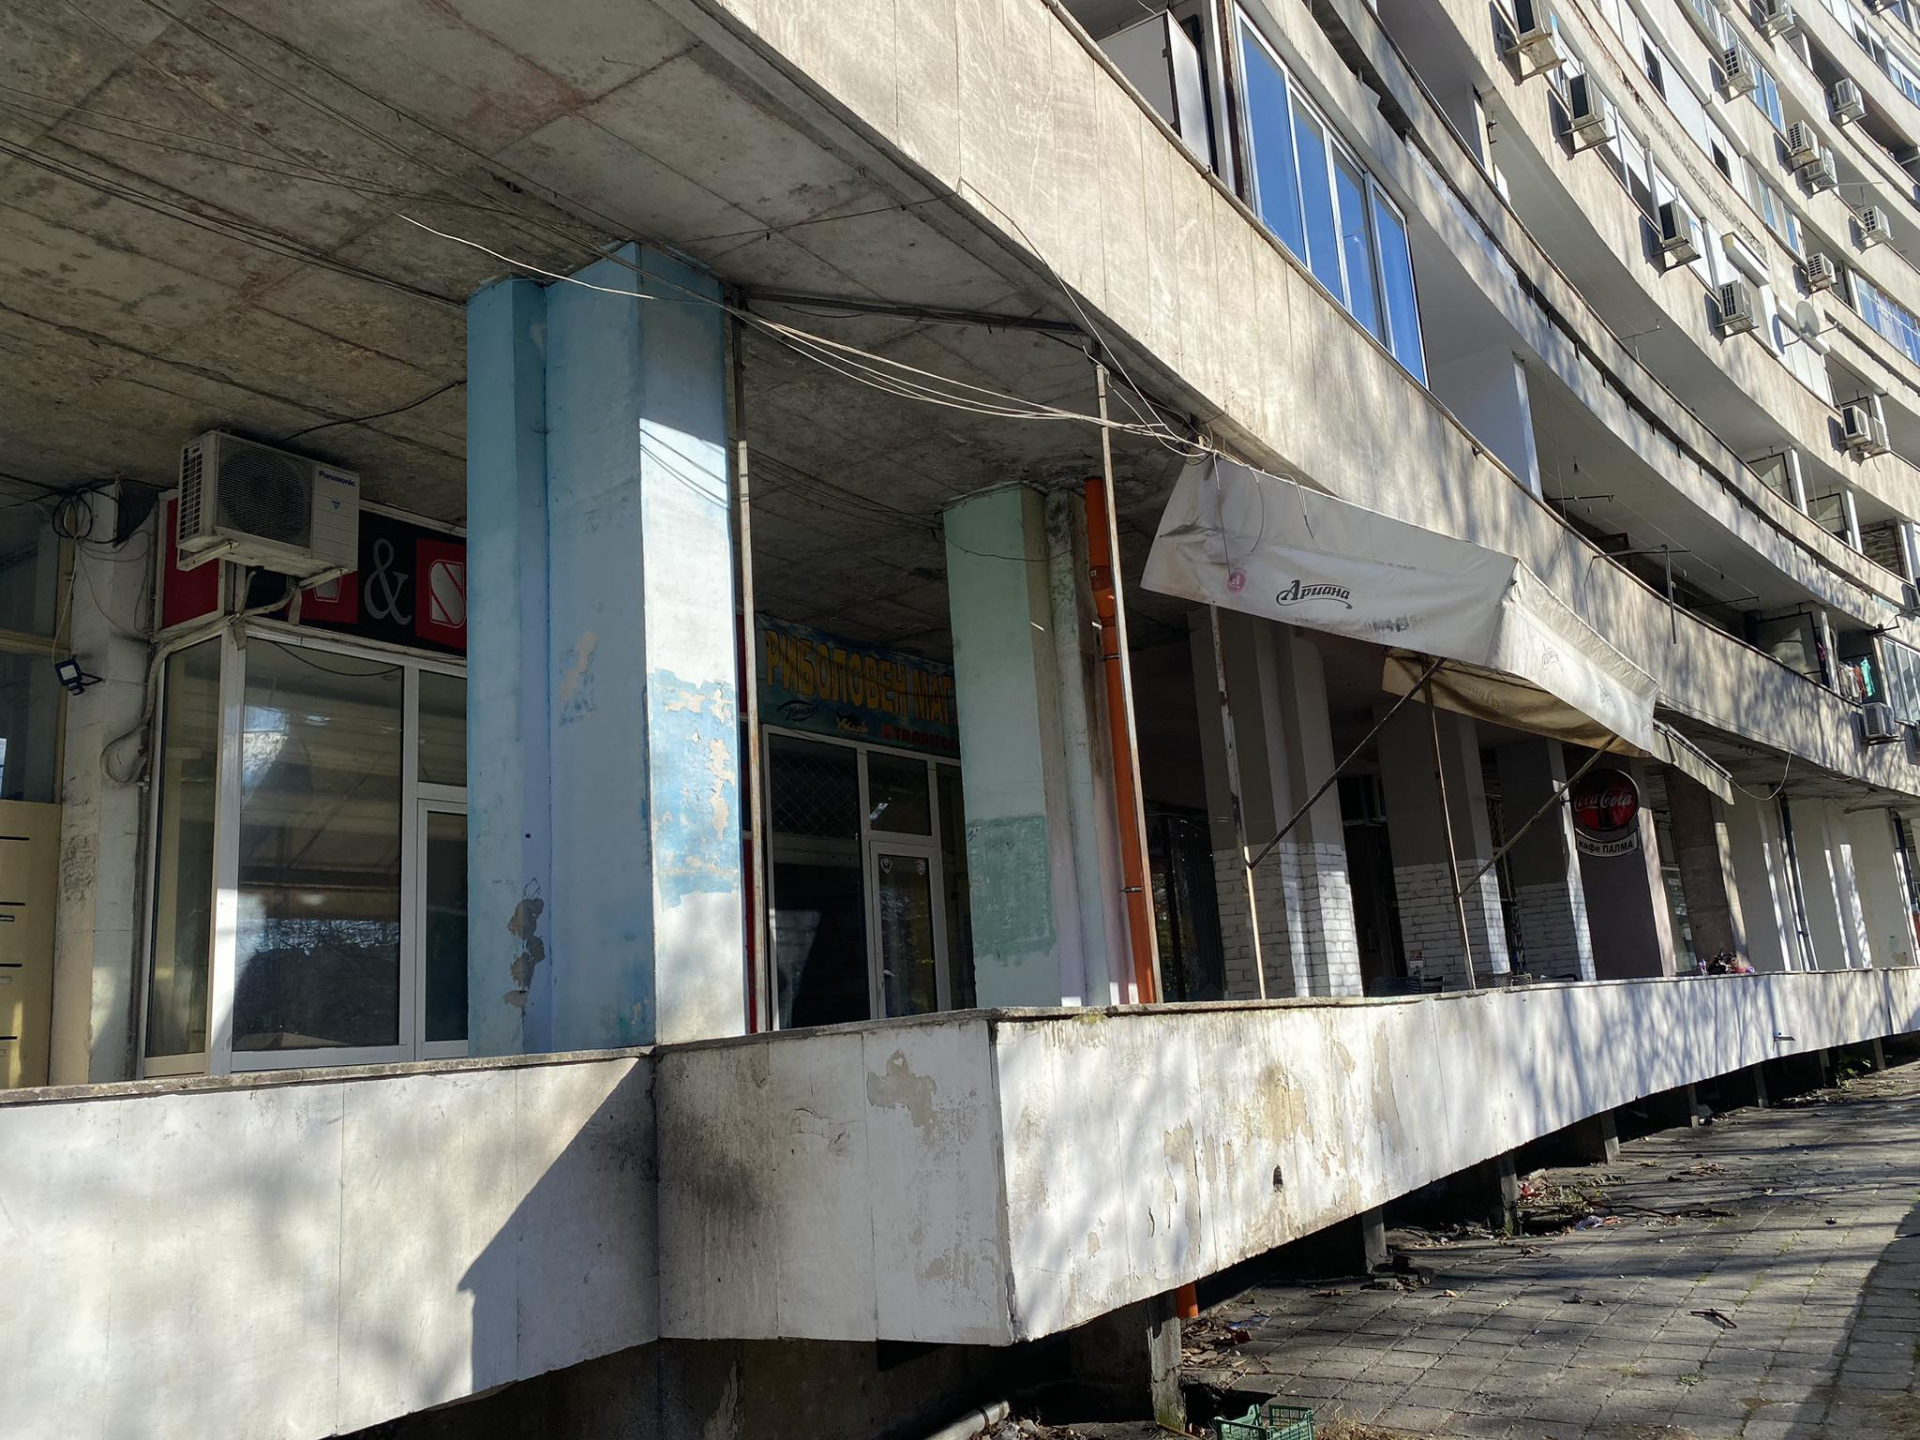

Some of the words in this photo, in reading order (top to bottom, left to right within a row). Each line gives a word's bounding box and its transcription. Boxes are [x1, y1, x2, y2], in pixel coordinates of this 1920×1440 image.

[319, 470, 356, 487] Panasonic
[364, 538, 412, 625] &
[1277, 580, 1352, 608] Ариана
[765, 629, 909, 719] РИБОЛОВЕН
[914, 669, 957, 723] МАГ
[1603, 840, 1634, 854] ПАЛМА
